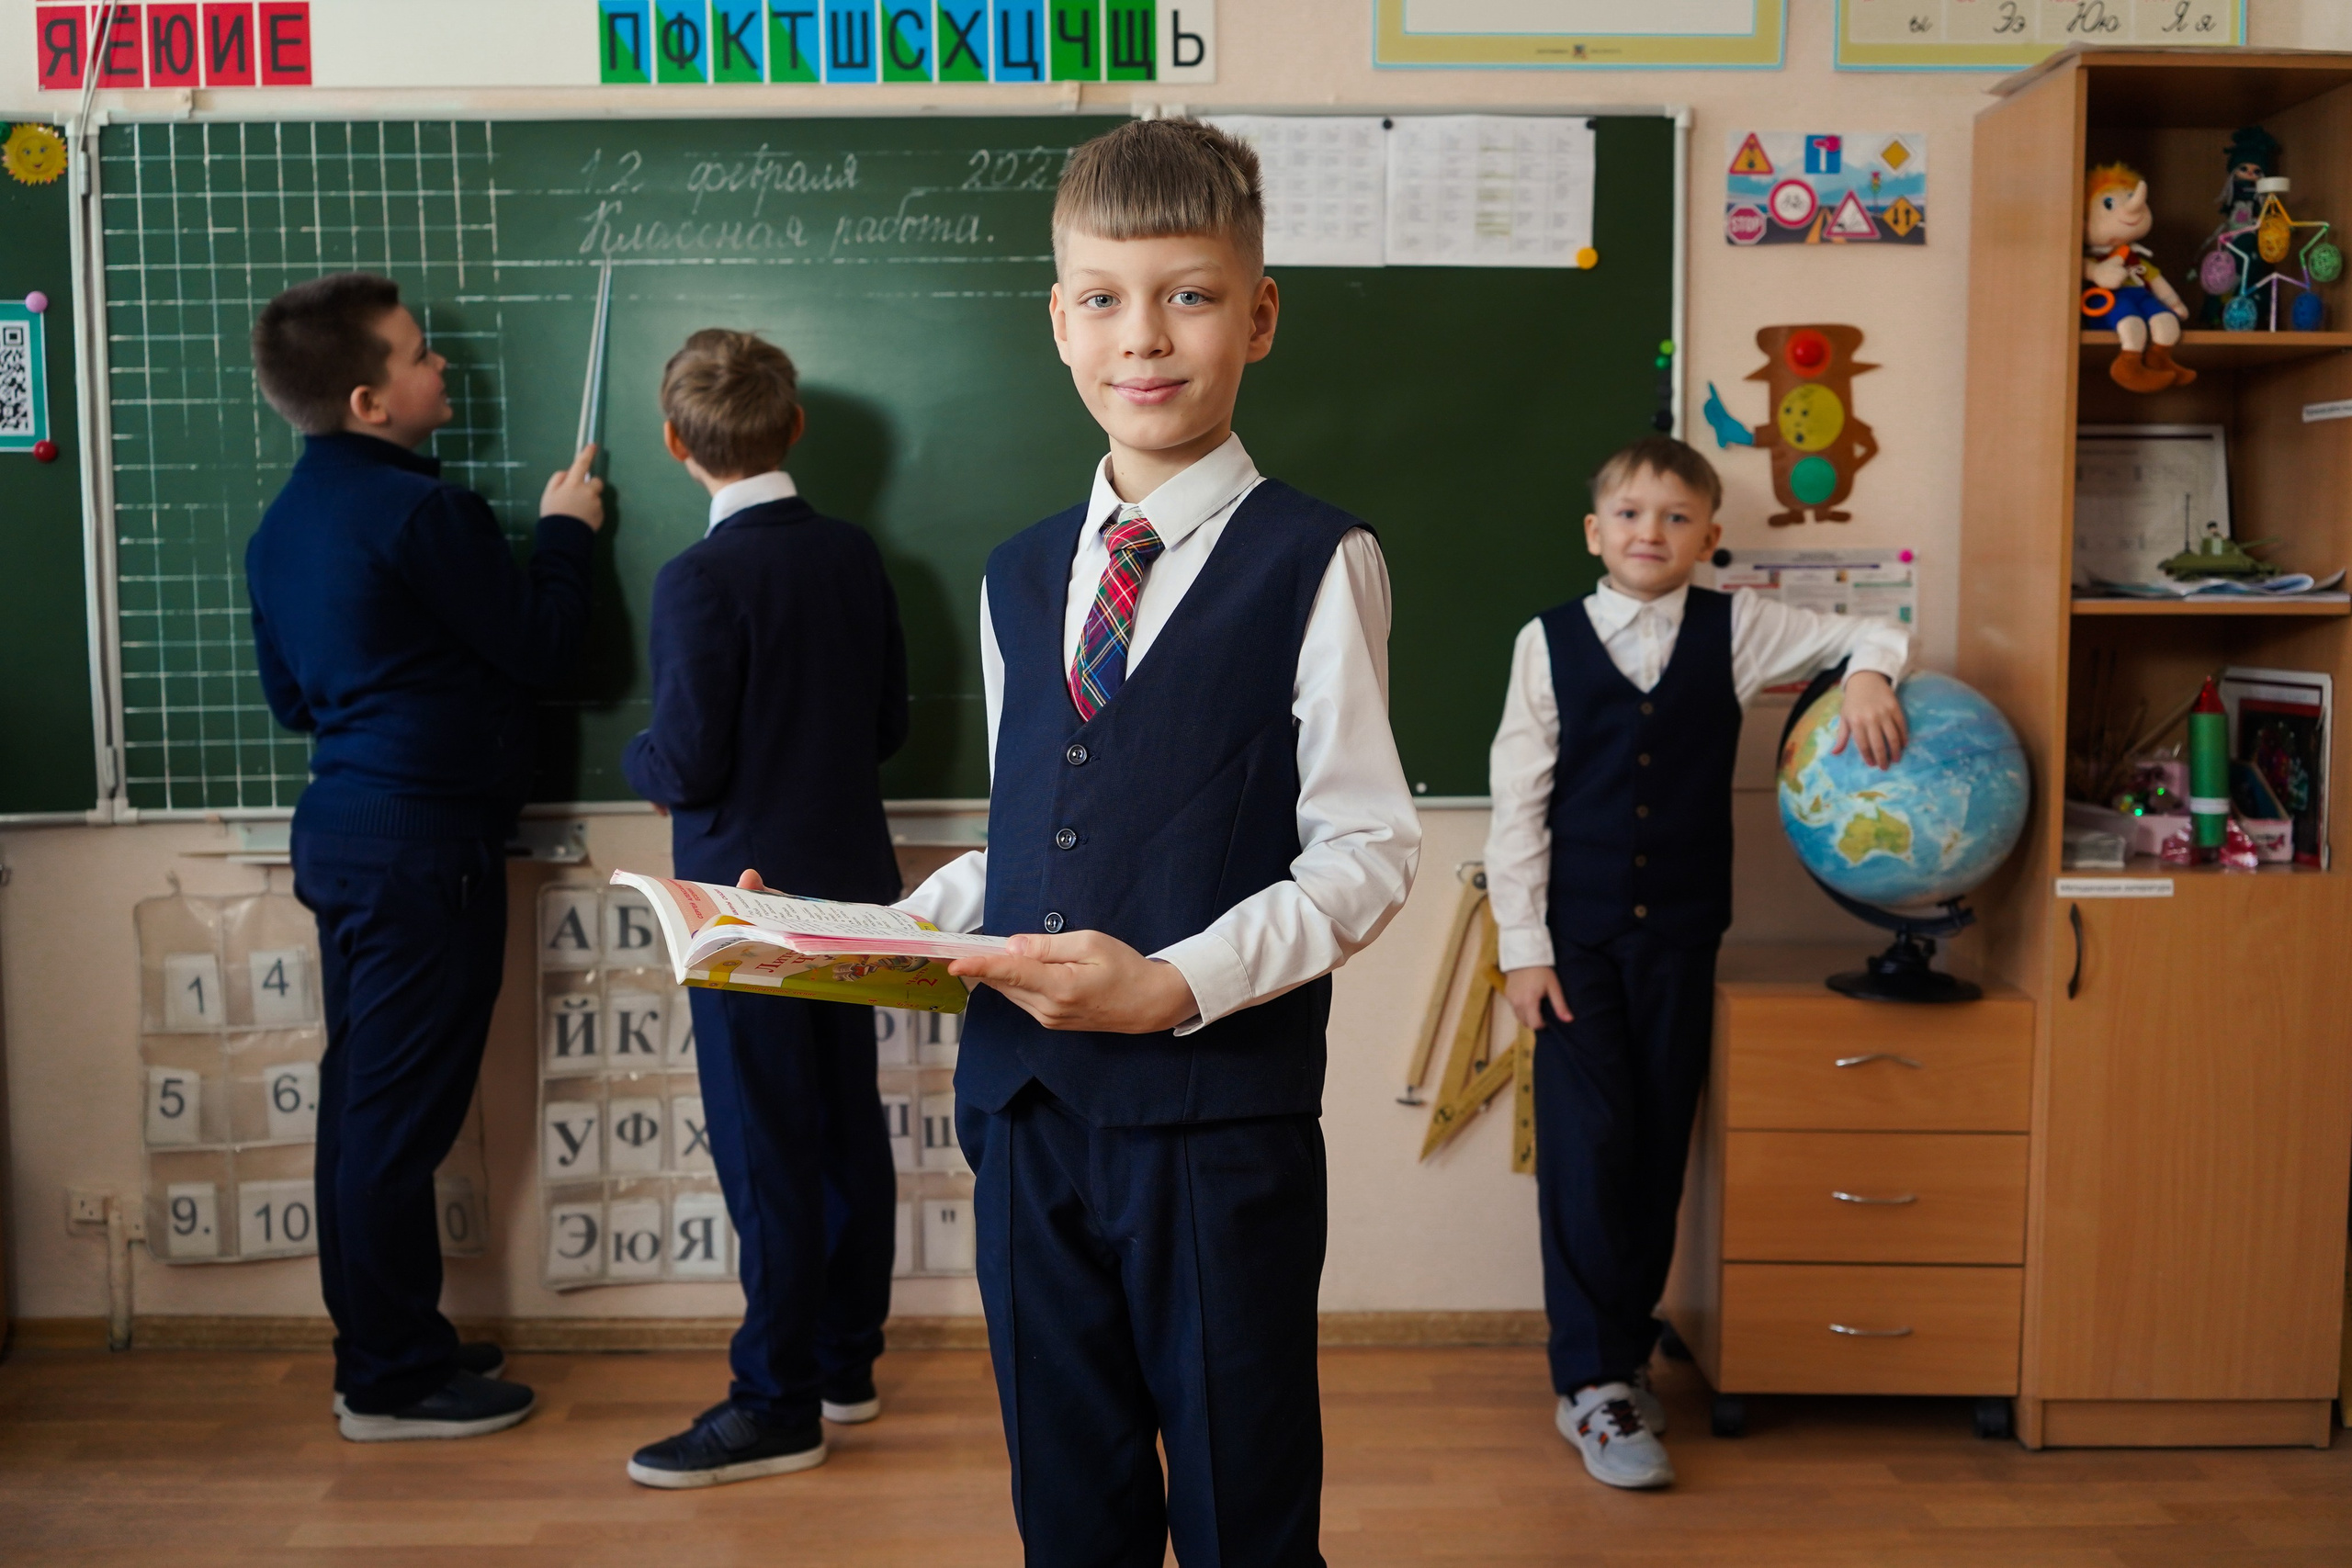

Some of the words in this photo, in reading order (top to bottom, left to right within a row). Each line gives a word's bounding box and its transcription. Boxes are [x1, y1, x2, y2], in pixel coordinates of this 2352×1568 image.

[44, 18, 79, 77] Я
[153, 14, 194, 75] Ю
[211, 15, 245, 73] И
[269, 14, 305, 73] Е
[607, 12, 640, 71] П
[661, 11, 700, 70] Ф
[721, 11, 758, 70] К
[773, 11, 814, 69] Т
[831, 10, 869, 69] Ш
[888, 9, 925, 71] С
[942, 10, 983, 69] Х
[1001, 10, 1039, 80] Ц
[1057, 9, 1091, 68] Ч
[1112, 9, 1153, 80] Щ
[1172, 9, 1205, 67] Ь
[686, 142, 859, 219] февраля
[961, 144, 1073, 190] 202
[577, 198, 808, 255] Классная
[829, 188, 995, 257] работа.
[548, 906, 591, 951] А
[616, 905, 652, 950] Б
[187, 976, 205, 1015] 1
[262, 957, 290, 998] 4
[555, 998, 596, 1057] Й
[617, 1010, 660, 1055] К
[159, 1077, 186, 1119] 5
[254, 1201, 311, 1243] 10
[556, 1213, 598, 1259] Э
[673, 1216, 717, 1260] Я
